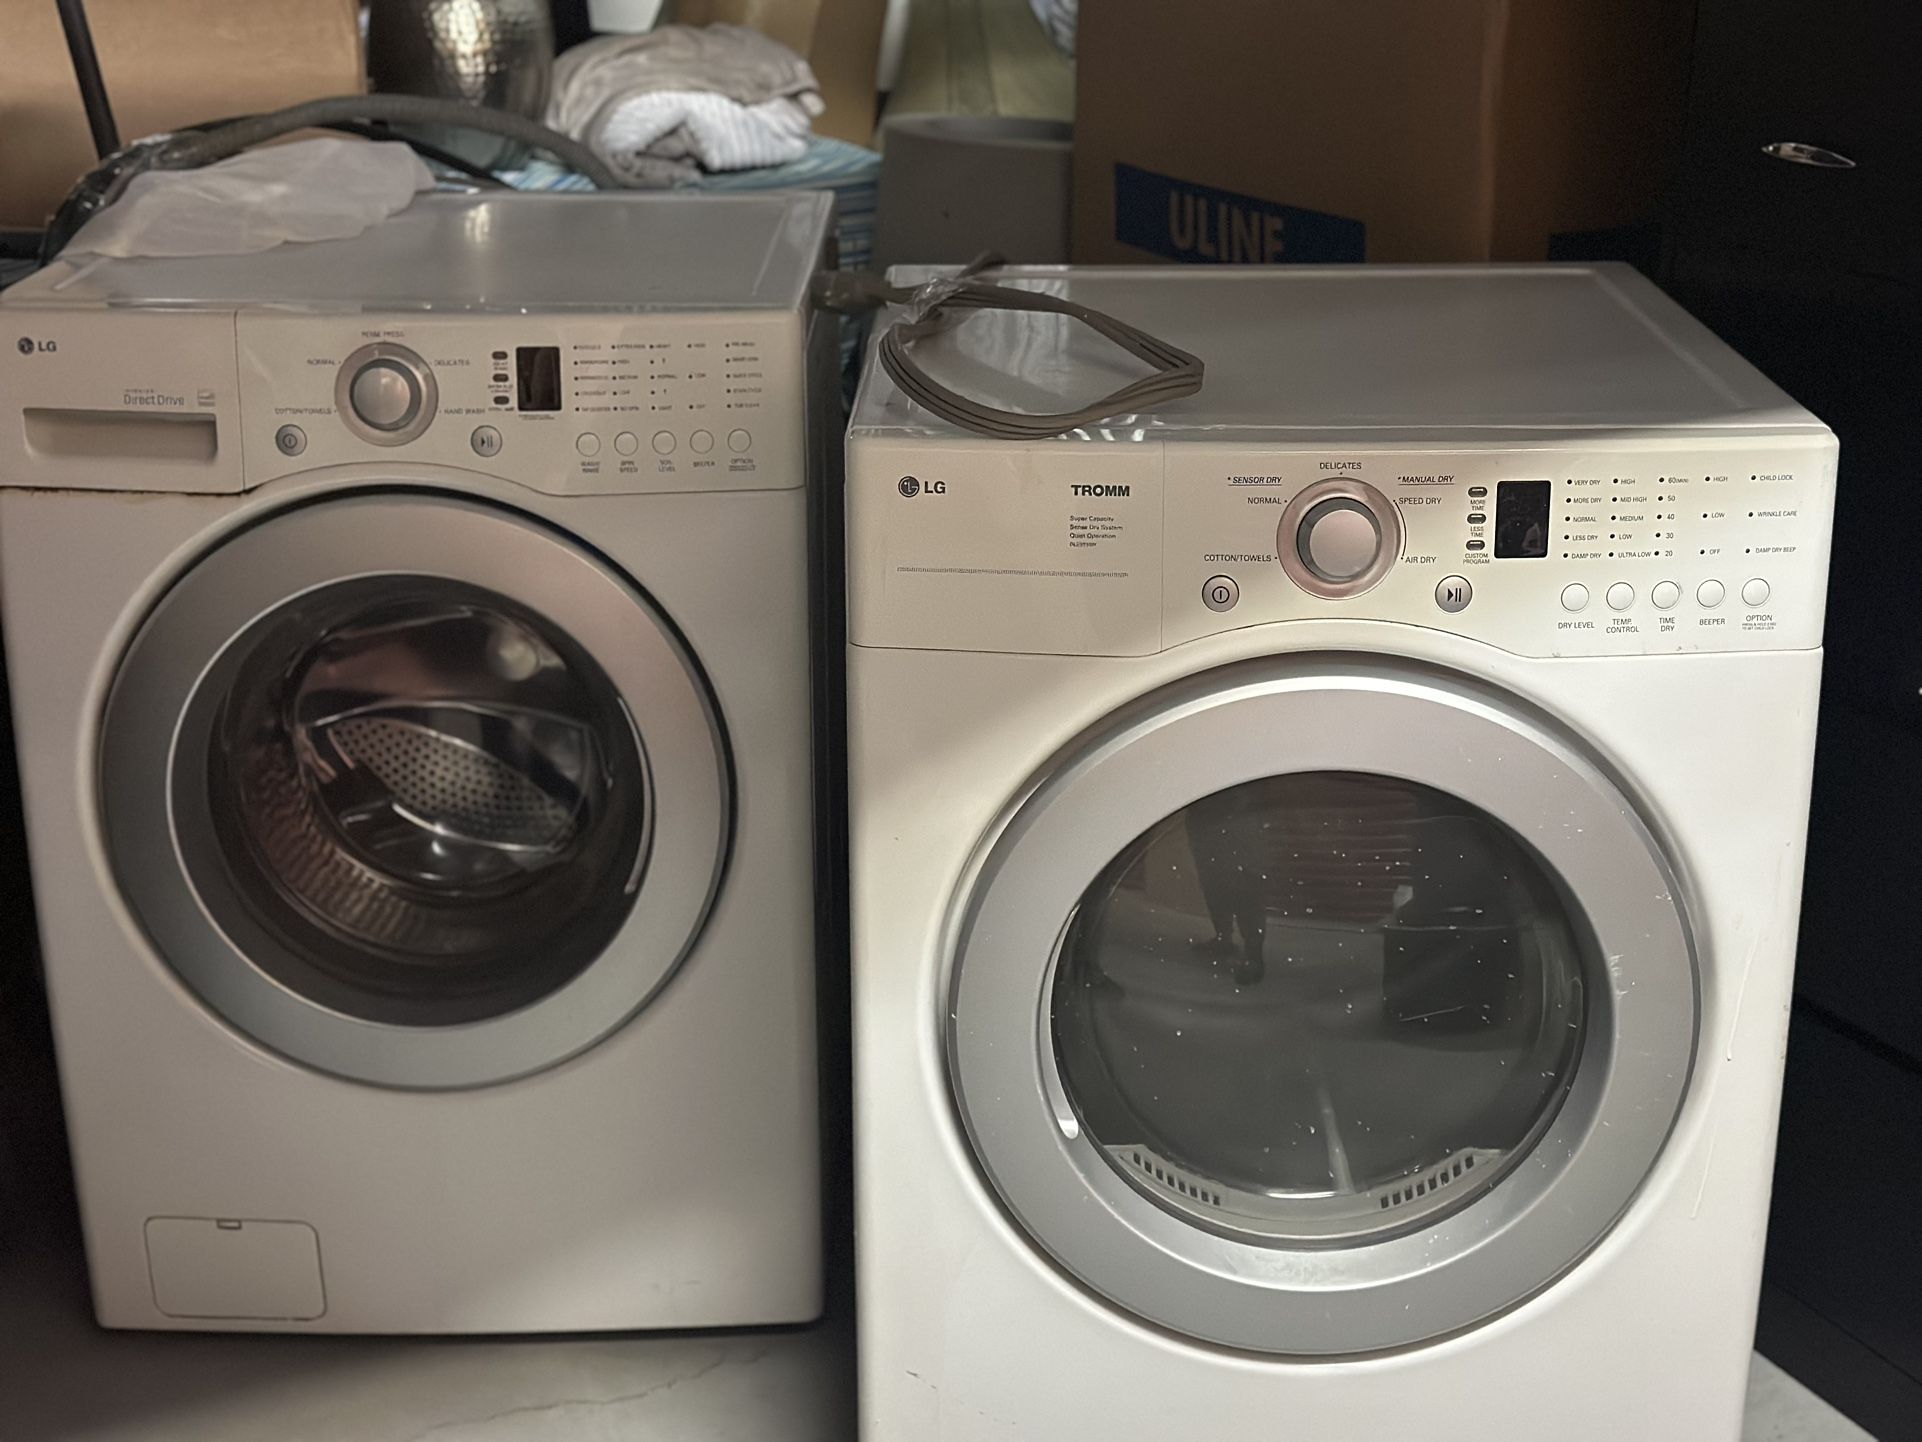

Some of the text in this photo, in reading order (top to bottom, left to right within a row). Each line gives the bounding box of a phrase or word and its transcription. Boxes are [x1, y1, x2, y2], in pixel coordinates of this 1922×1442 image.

[1168, 190, 1285, 263] ULINE
[37, 340, 57, 352] LG
[123, 394, 155, 406] Direct
[157, 394, 185, 407] Drive
[1319, 462, 1362, 470] DELICATES
[1232, 476, 1282, 484] SENSOR DRY
[1438, 475, 1455, 483] DRY
[923, 480, 946, 494] LG
[1070, 484, 1131, 497] TROMM
[1247, 497, 1282, 505] NORMAL
[1398, 497, 1442, 505] SPEED DRY
[1087, 532, 1117, 540] Operation
[1203, 554, 1272, 562] COTTON/TOWELS
[1405, 556, 1437, 564] AIR DRY
[1612, 618, 1632, 626] TEMP.
[1699, 618, 1726, 626] BEEPER
[1745, 614, 1773, 622] OPTION
[1574, 621, 1595, 629] LEVEL
[1605, 625, 1640, 634] CONTROL
